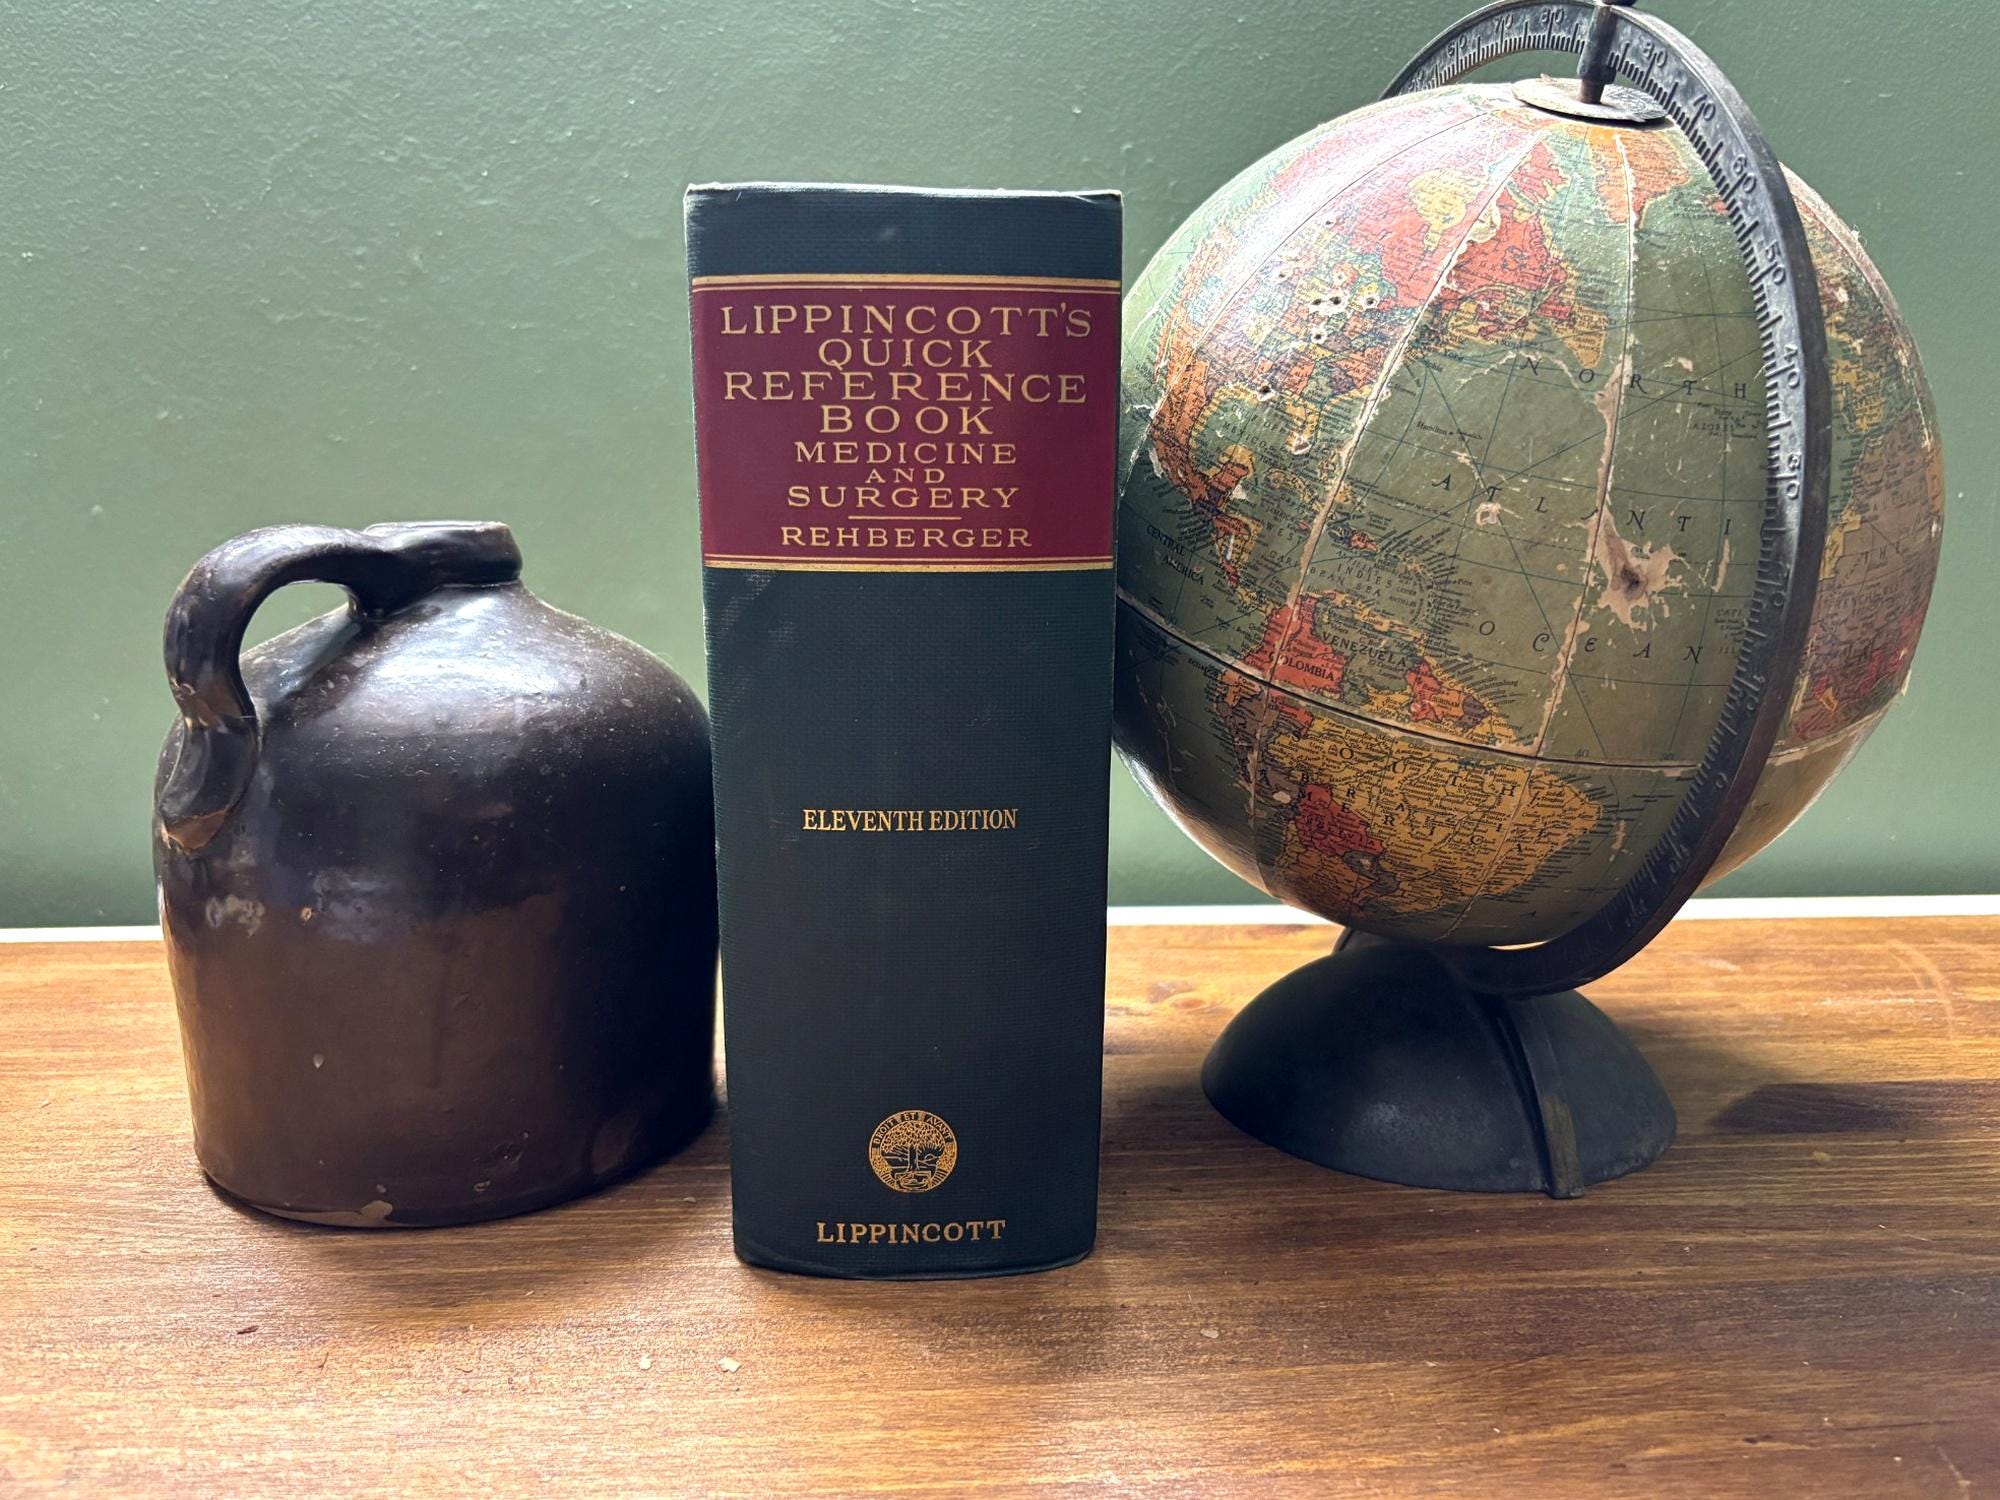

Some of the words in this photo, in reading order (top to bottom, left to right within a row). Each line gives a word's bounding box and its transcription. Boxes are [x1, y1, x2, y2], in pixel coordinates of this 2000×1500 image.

[1732, 153, 1757, 194] 60
[1764, 239, 1786, 286] 50
[721, 302, 1092, 337] LIPPINCOTT'S
[818, 338, 993, 371] QUICK
[1783, 343, 1801, 390] 40
[724, 371, 1088, 404] REFERENCE
[820, 404, 994, 435] BOOK
[794, 441, 1018, 465] MEDICINE
[864, 467, 946, 484] AND
[787, 486, 1019, 509] SURGERY
[780, 526, 1033, 548] REHBERGER
[1322, 631, 1407, 667] VENEZUELA
[802, 809, 924, 832] ELEVENTH
[928, 808, 1019, 831] EDITION
[873, 1118, 895, 1145] DROIT
[903, 1112, 917, 1121] ET
[926, 1117, 952, 1140] AVANT
[816, 1219, 1006, 1244] LIPPINCOTT
